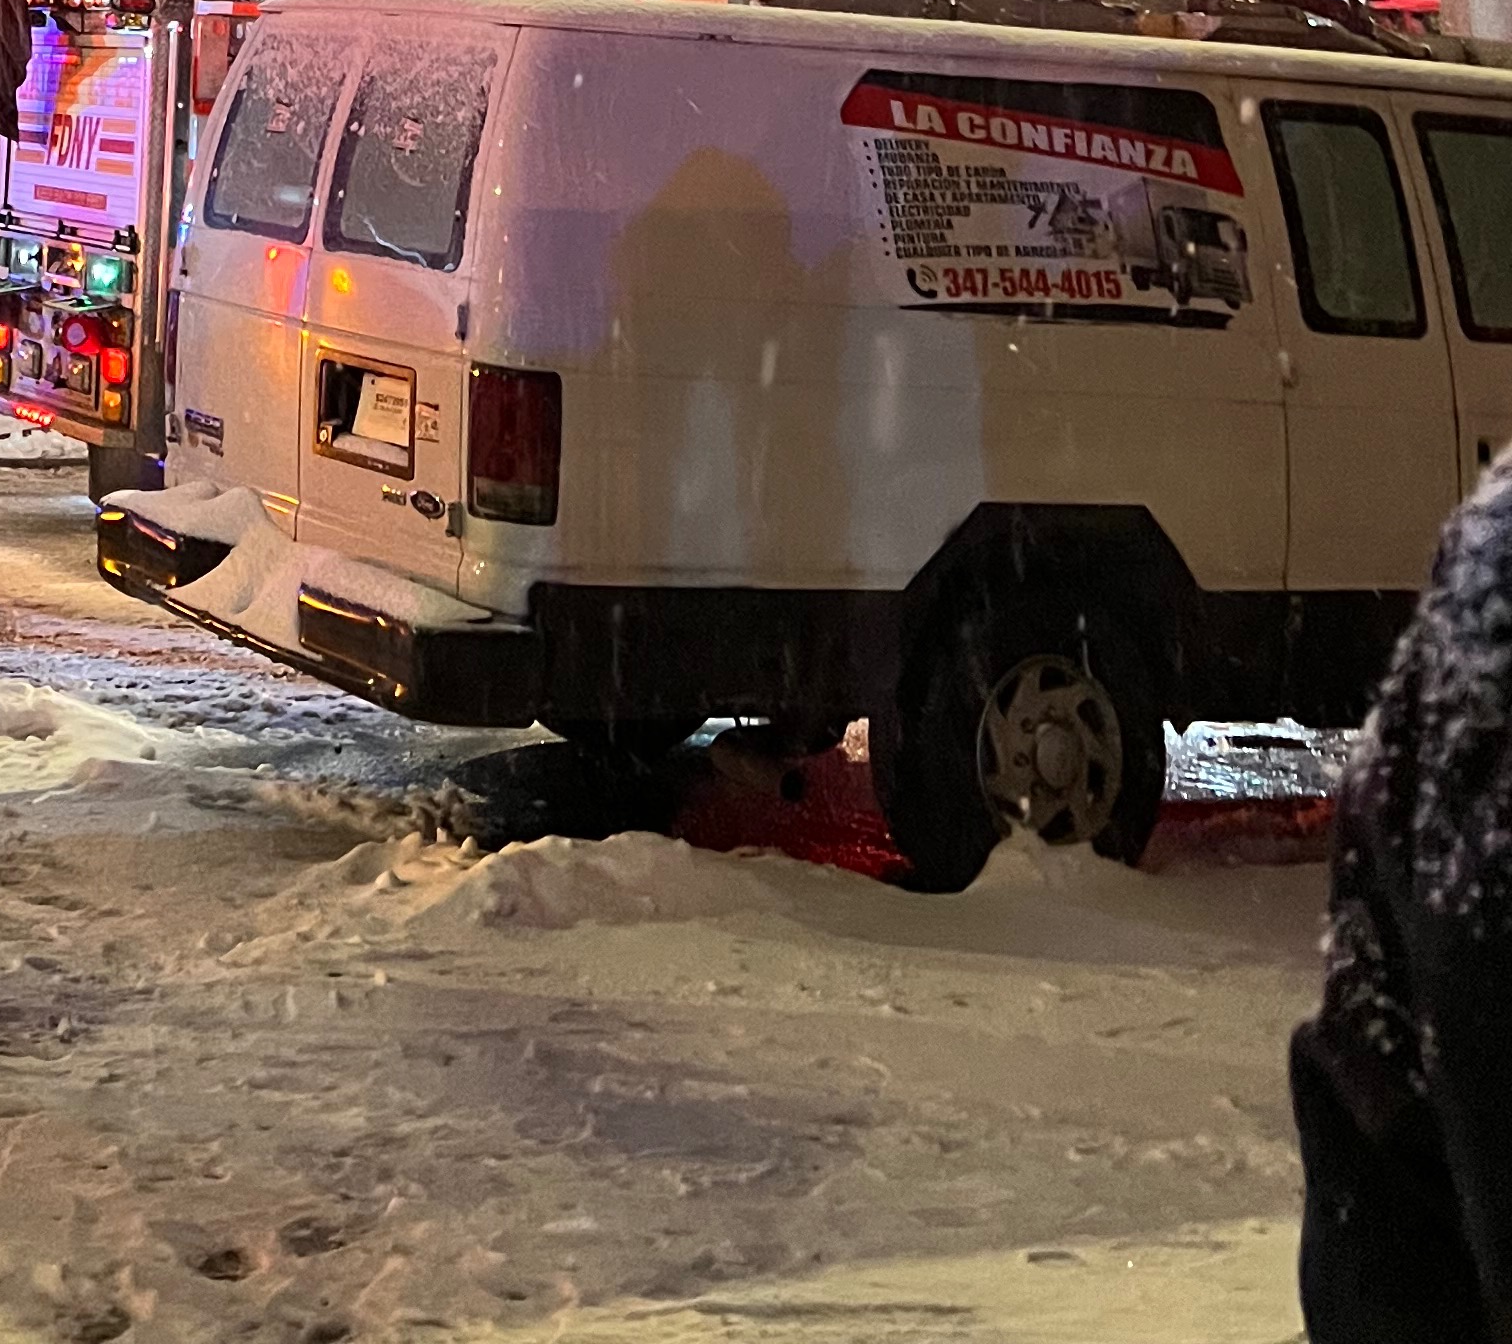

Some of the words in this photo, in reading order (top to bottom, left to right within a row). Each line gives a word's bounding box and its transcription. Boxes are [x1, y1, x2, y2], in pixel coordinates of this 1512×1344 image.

[47, 114, 101, 170] FDNY
[875, 139, 930, 151] DELIVERY
[890, 99, 946, 134] LA
[957, 112, 1198, 179] CONFIANZA
[915, 165, 943, 178] TIPO
[947, 165, 961, 178] DE
[885, 192, 900, 204] DE
[903, 192, 936, 204] CASA
[966, 244, 992, 257] TIPO
[943, 266, 1123, 299] 347-544-4015
